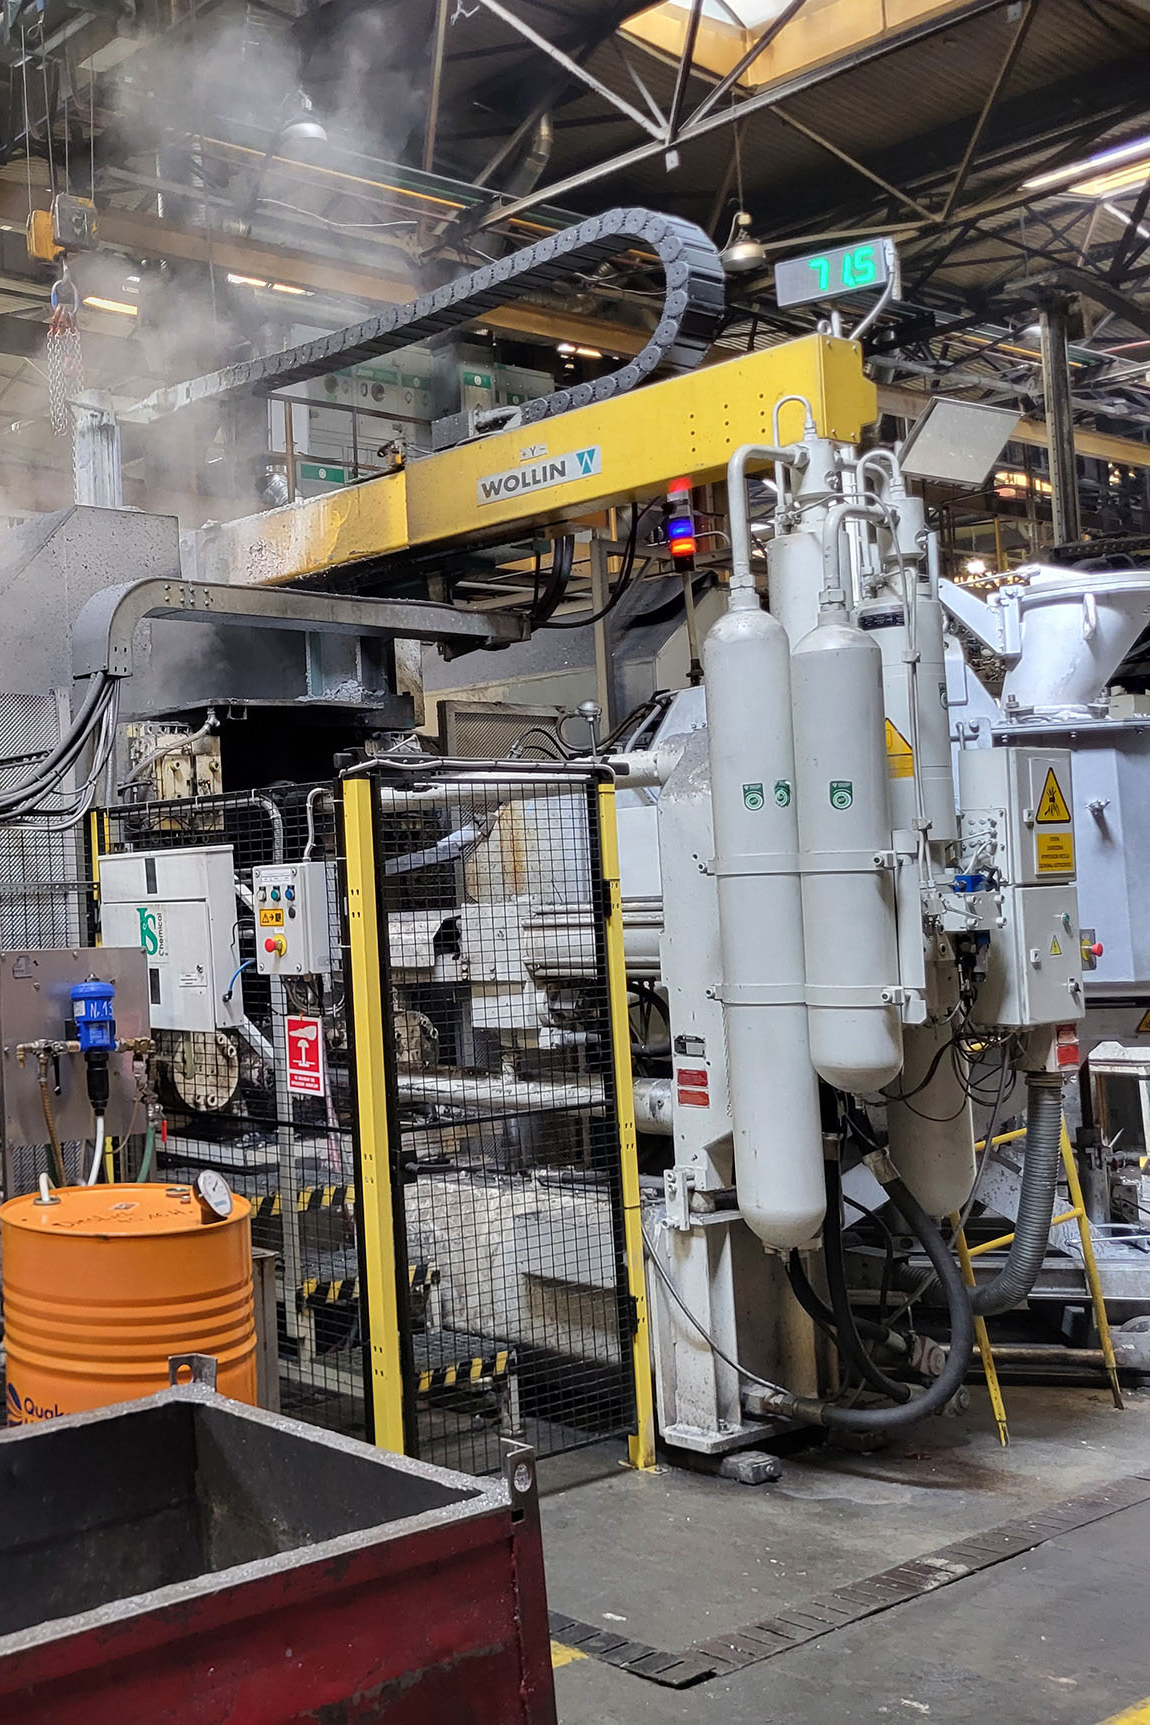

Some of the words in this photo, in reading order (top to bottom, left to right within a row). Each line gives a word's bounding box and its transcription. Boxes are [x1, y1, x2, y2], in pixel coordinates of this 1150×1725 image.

[481, 460, 567, 499] WOLLIN
[156, 912, 165, 957] Chemical
[23, 1396, 69, 1421] Quak
